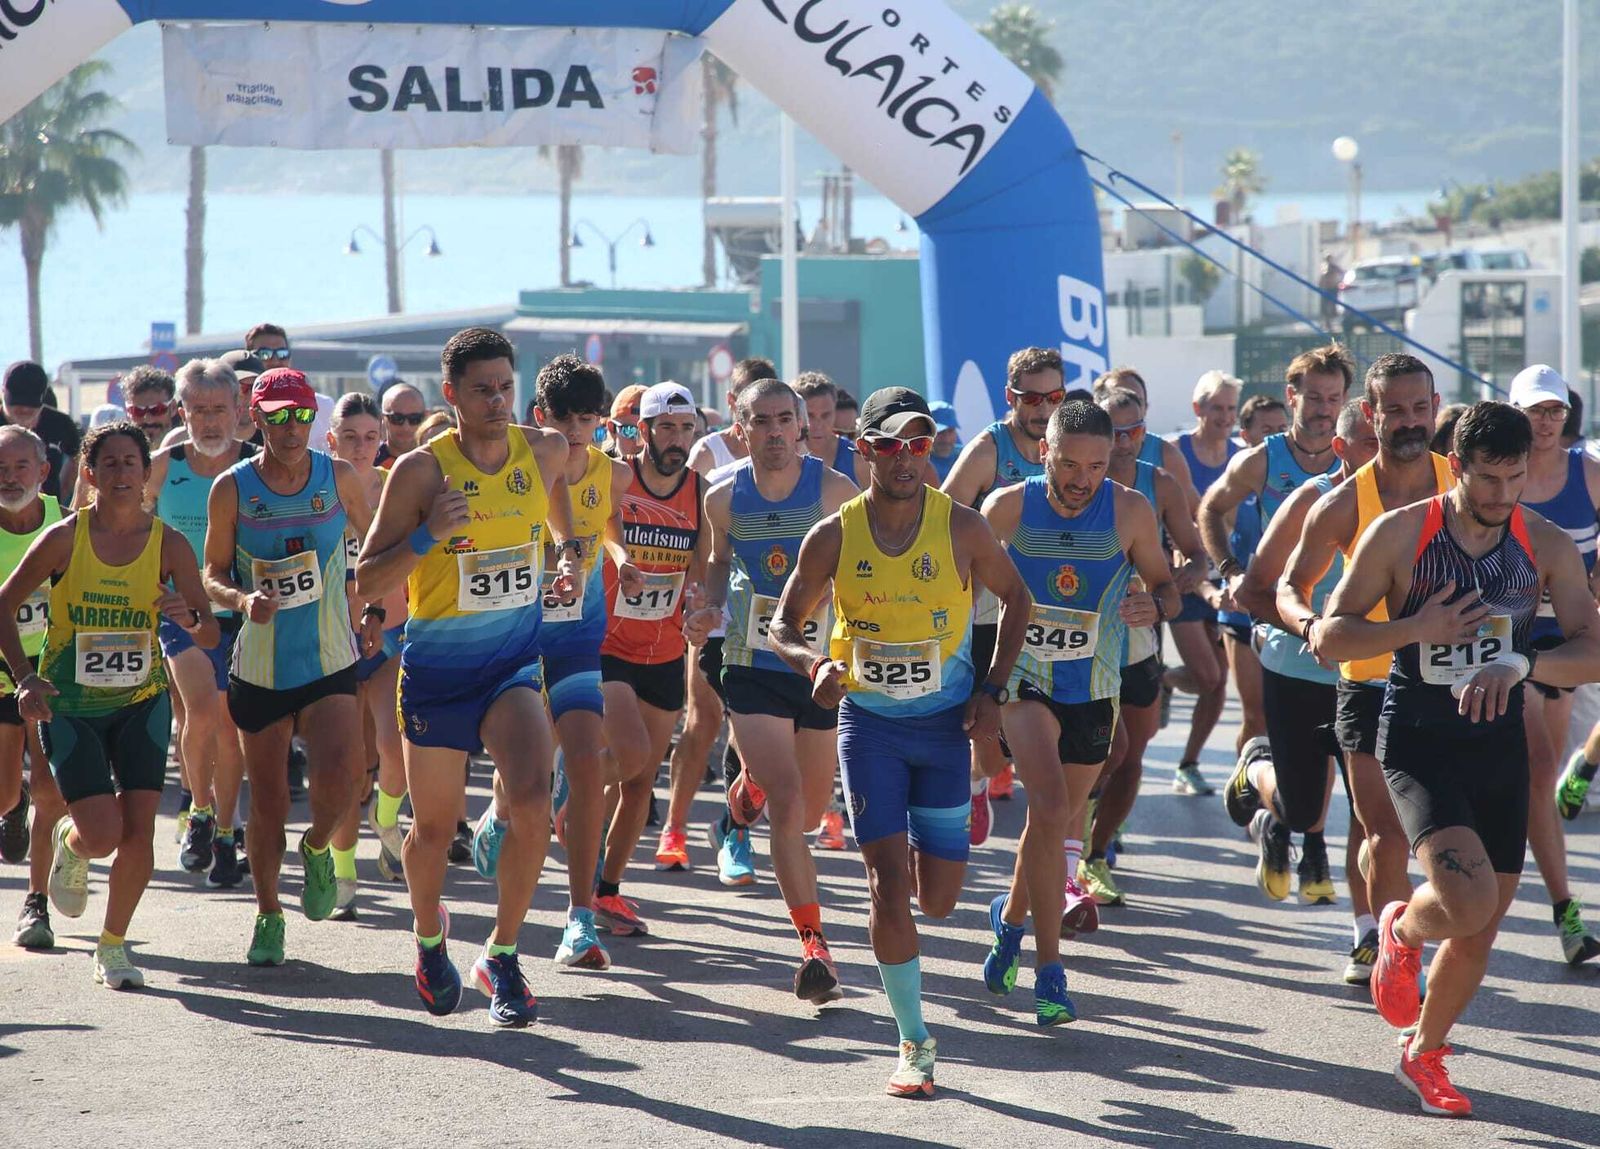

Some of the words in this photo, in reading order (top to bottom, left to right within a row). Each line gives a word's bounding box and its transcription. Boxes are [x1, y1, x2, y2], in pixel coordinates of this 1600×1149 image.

[347, 64, 605, 112] SALIDA
[761, 0, 986, 177] ULAICA
[261, 570, 315, 597] 156
[470, 565, 532, 596] 315
[82, 591, 130, 607] RUNNERS
[758, 615, 818, 642] 32
[1025, 624, 1088, 649] 349
[85, 652, 143, 673] 245
[1431, 638, 1501, 666] 212
[863, 661, 931, 685] 325
